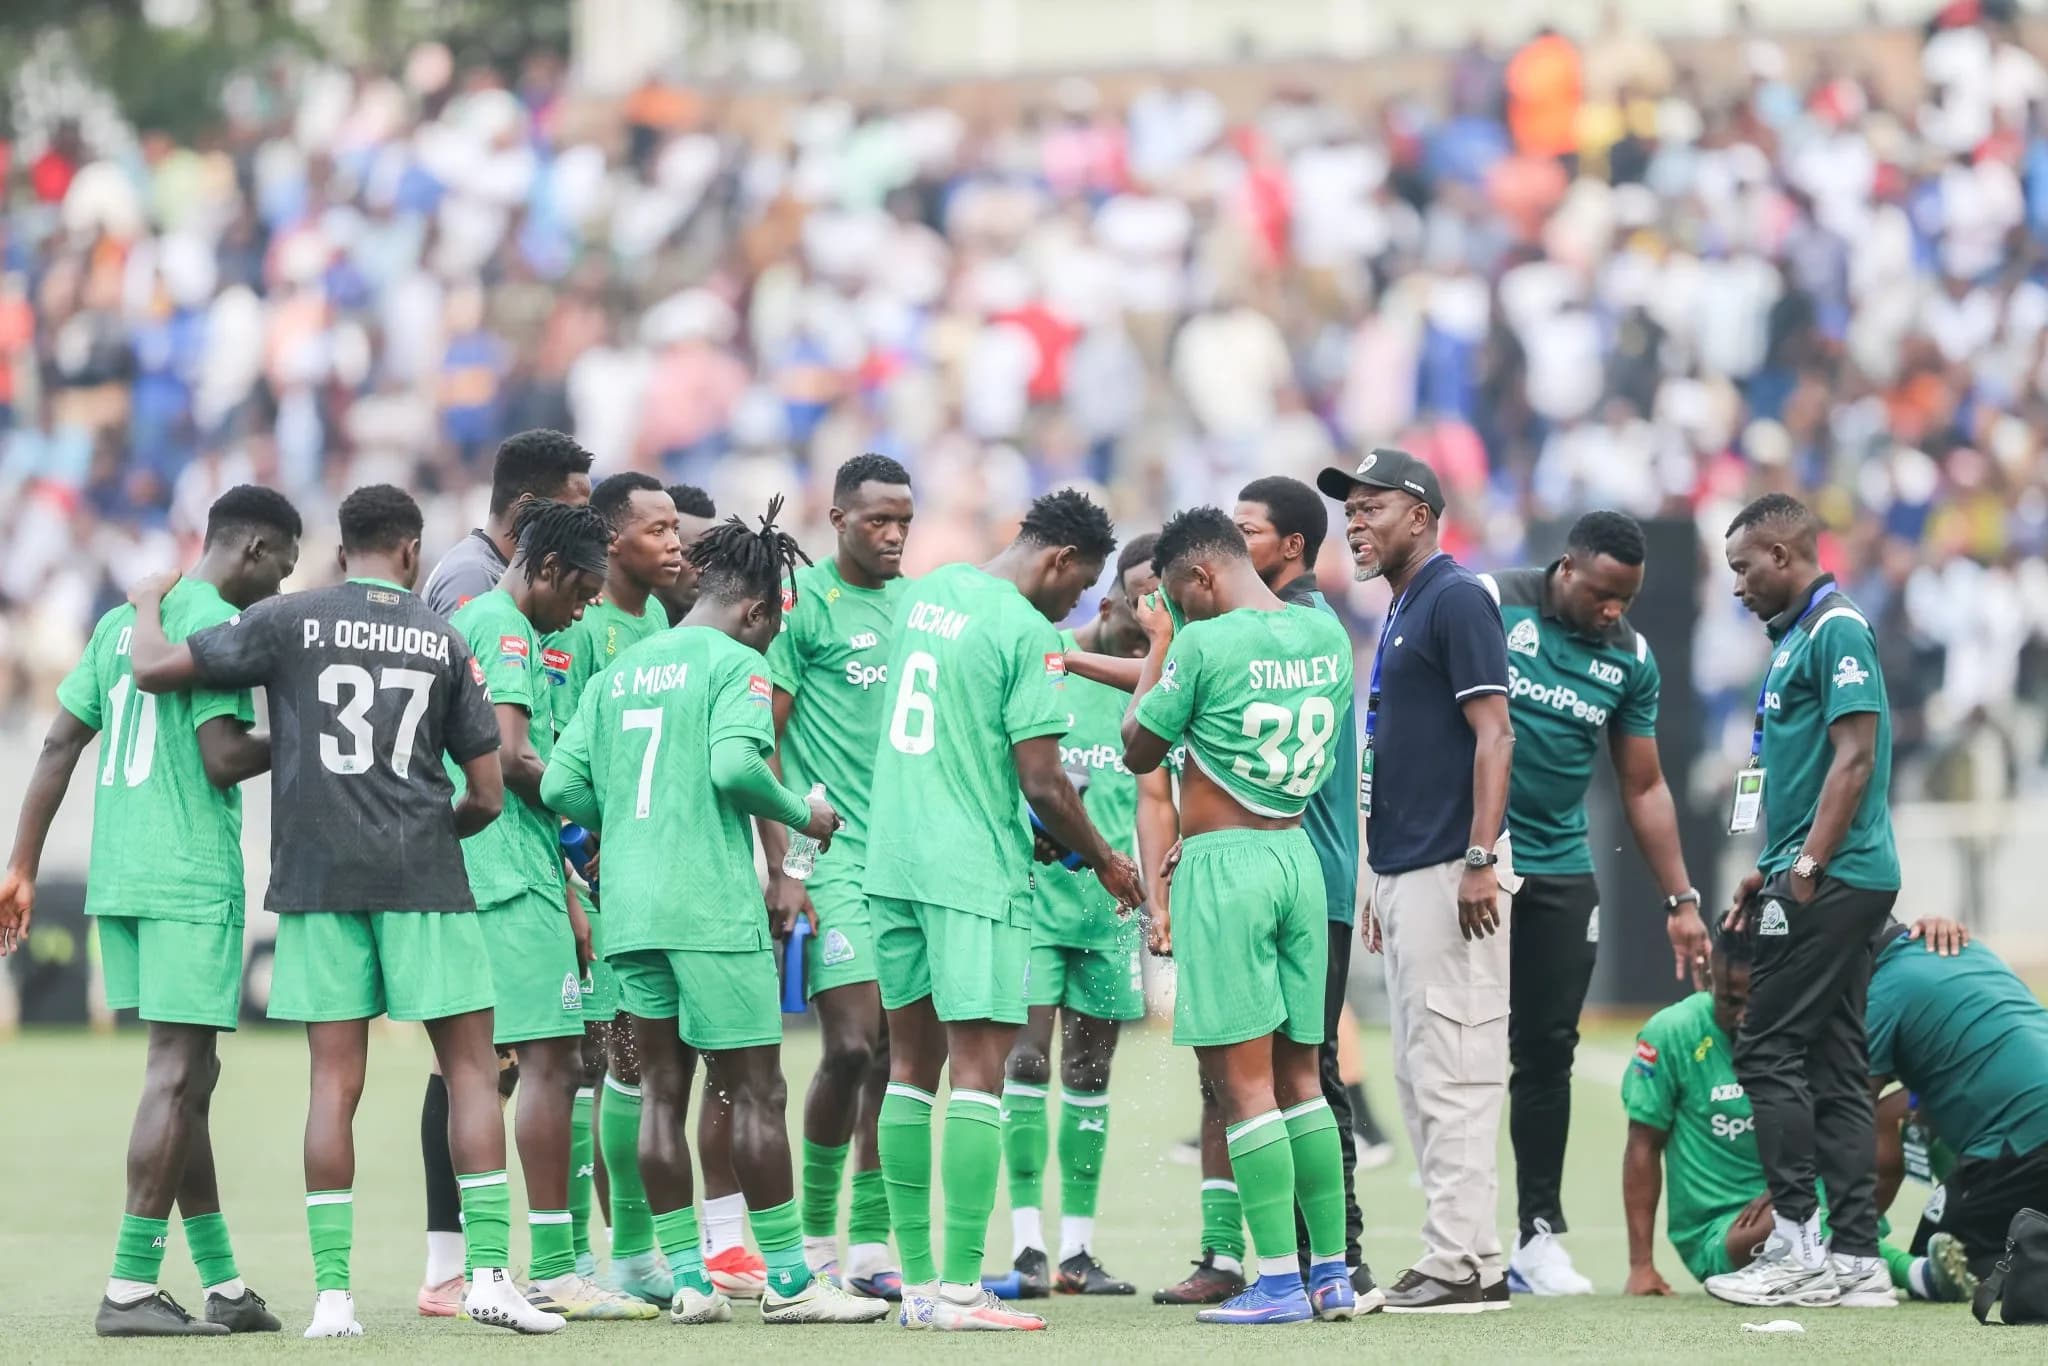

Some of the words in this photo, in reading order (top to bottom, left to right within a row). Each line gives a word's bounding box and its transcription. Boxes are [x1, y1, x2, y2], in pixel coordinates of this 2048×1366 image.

[303, 618, 326, 649] P.
[334, 619, 450, 666] OCHUOGA
[907, 600, 970, 640] OCRAN
[318, 663, 437, 780] 37
[632, 662, 688, 695] MUSA
[889, 650, 939, 756] 6
[1249, 654, 1339, 690] STANLEY
[101, 673, 157, 788] 10
[622, 706, 664, 820] 7
[1231, 696, 1335, 798] 38
